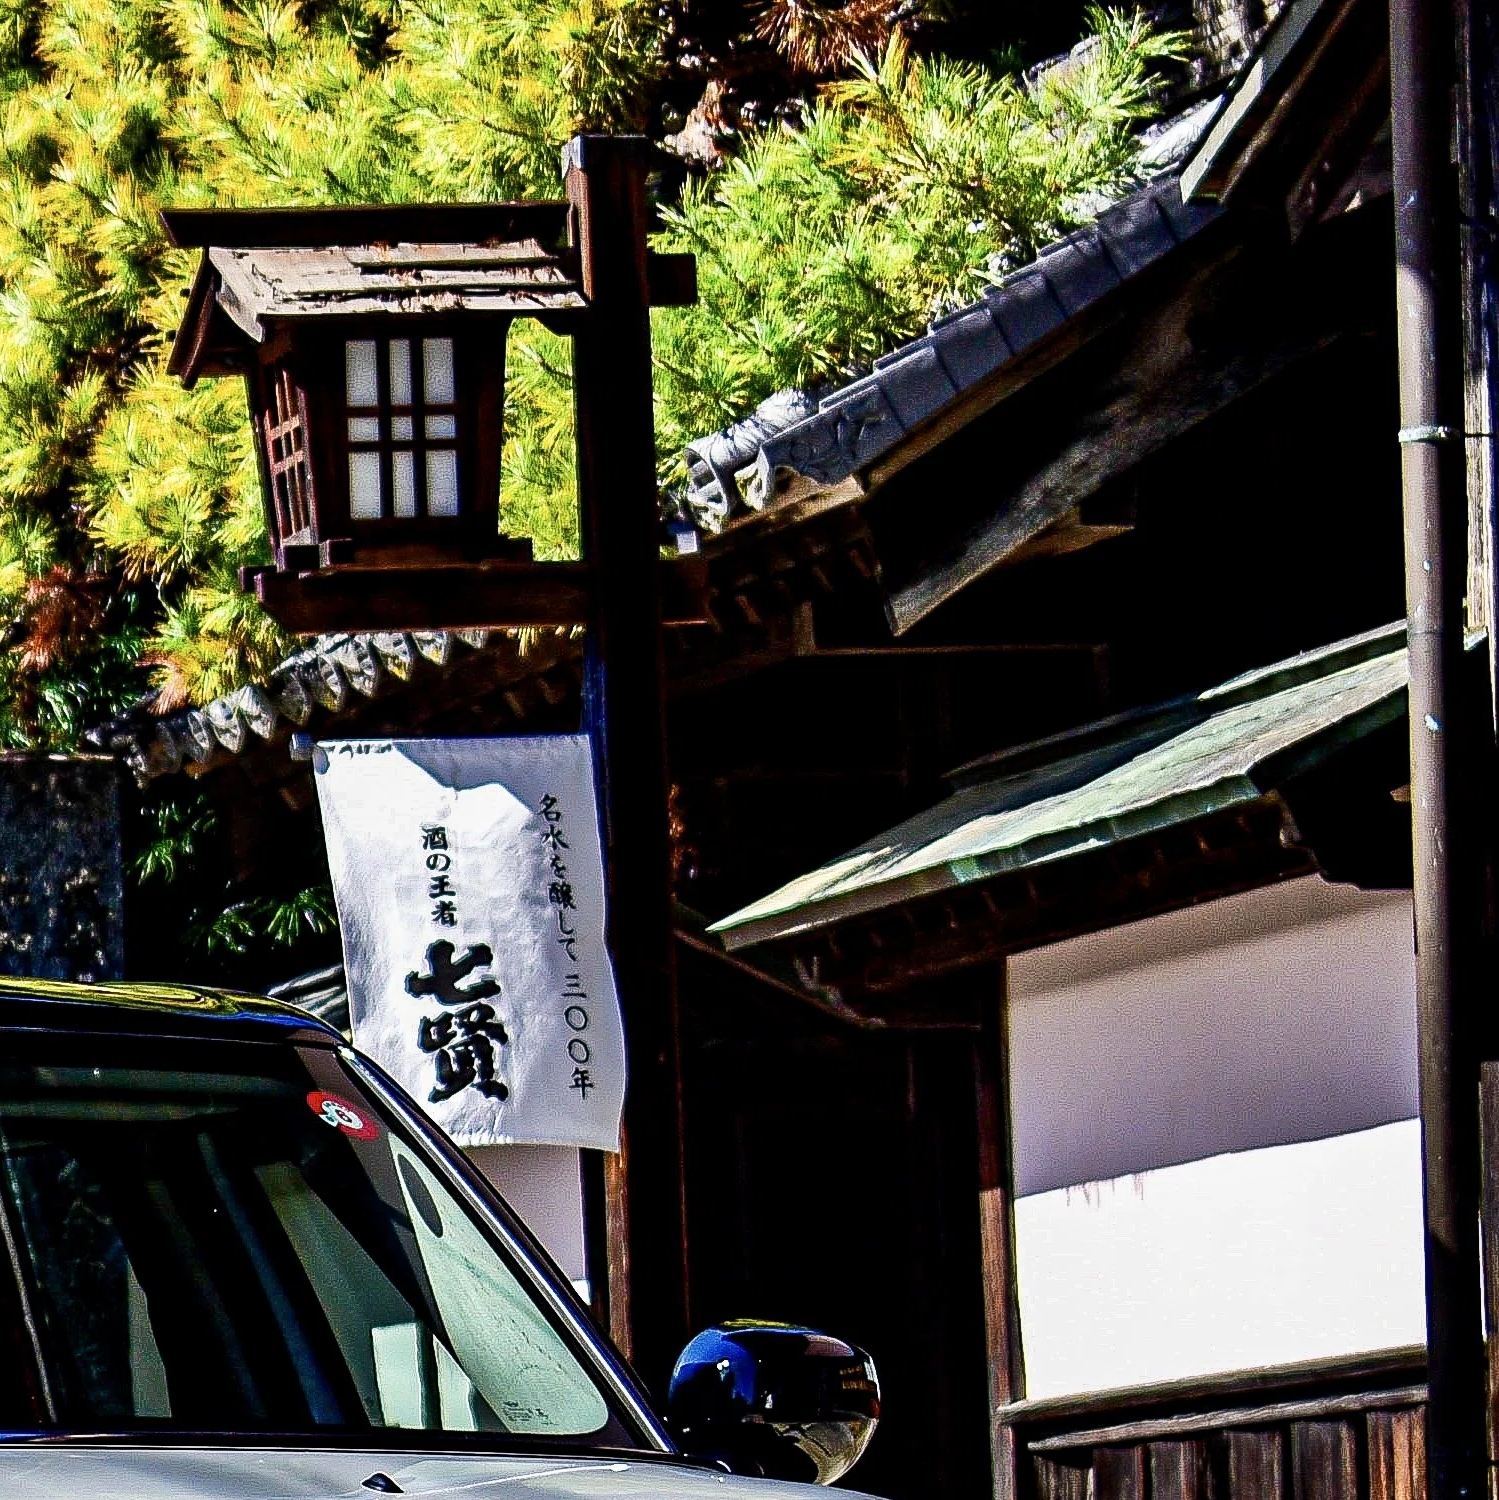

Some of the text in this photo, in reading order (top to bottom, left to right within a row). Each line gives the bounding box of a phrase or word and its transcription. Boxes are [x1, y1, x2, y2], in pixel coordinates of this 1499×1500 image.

[421, 825, 458, 927] 酒の王者
[404, 938, 509, 1103] 七賢
